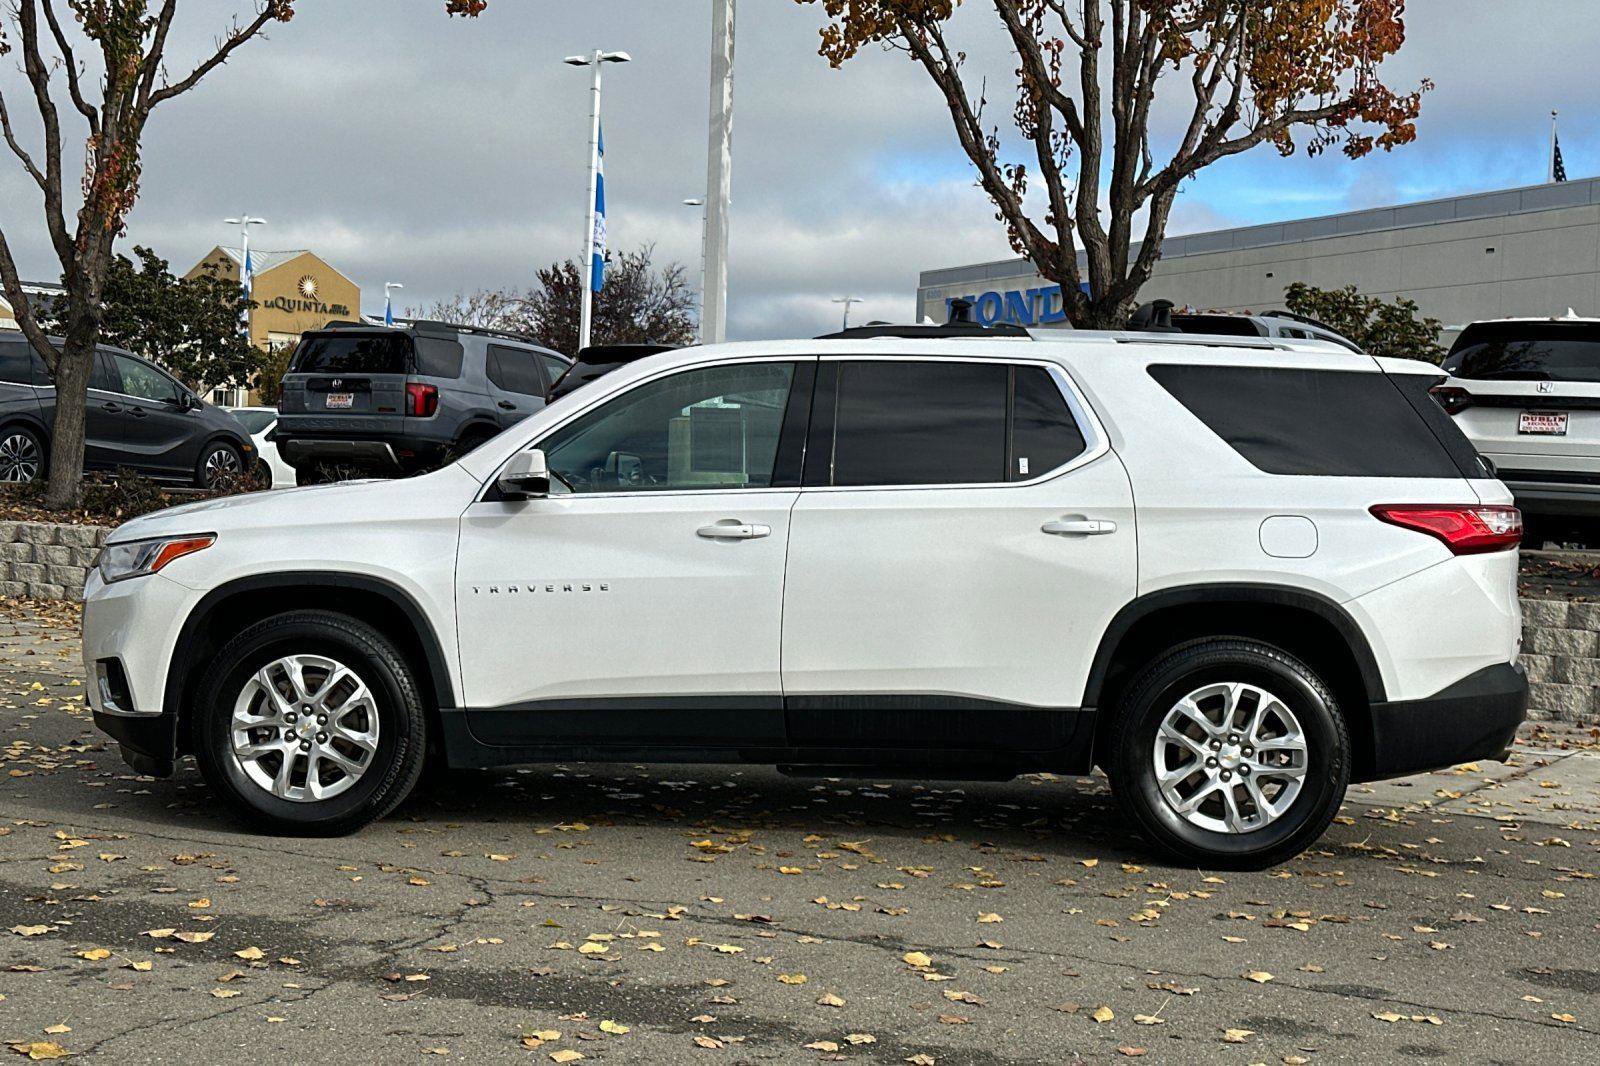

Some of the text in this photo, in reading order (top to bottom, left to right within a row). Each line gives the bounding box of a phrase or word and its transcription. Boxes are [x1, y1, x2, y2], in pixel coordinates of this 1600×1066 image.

[275, 296, 328, 314] QUINTA
[946, 283, 1093, 326] OND
[472, 583, 609, 594] TRAVERSE
